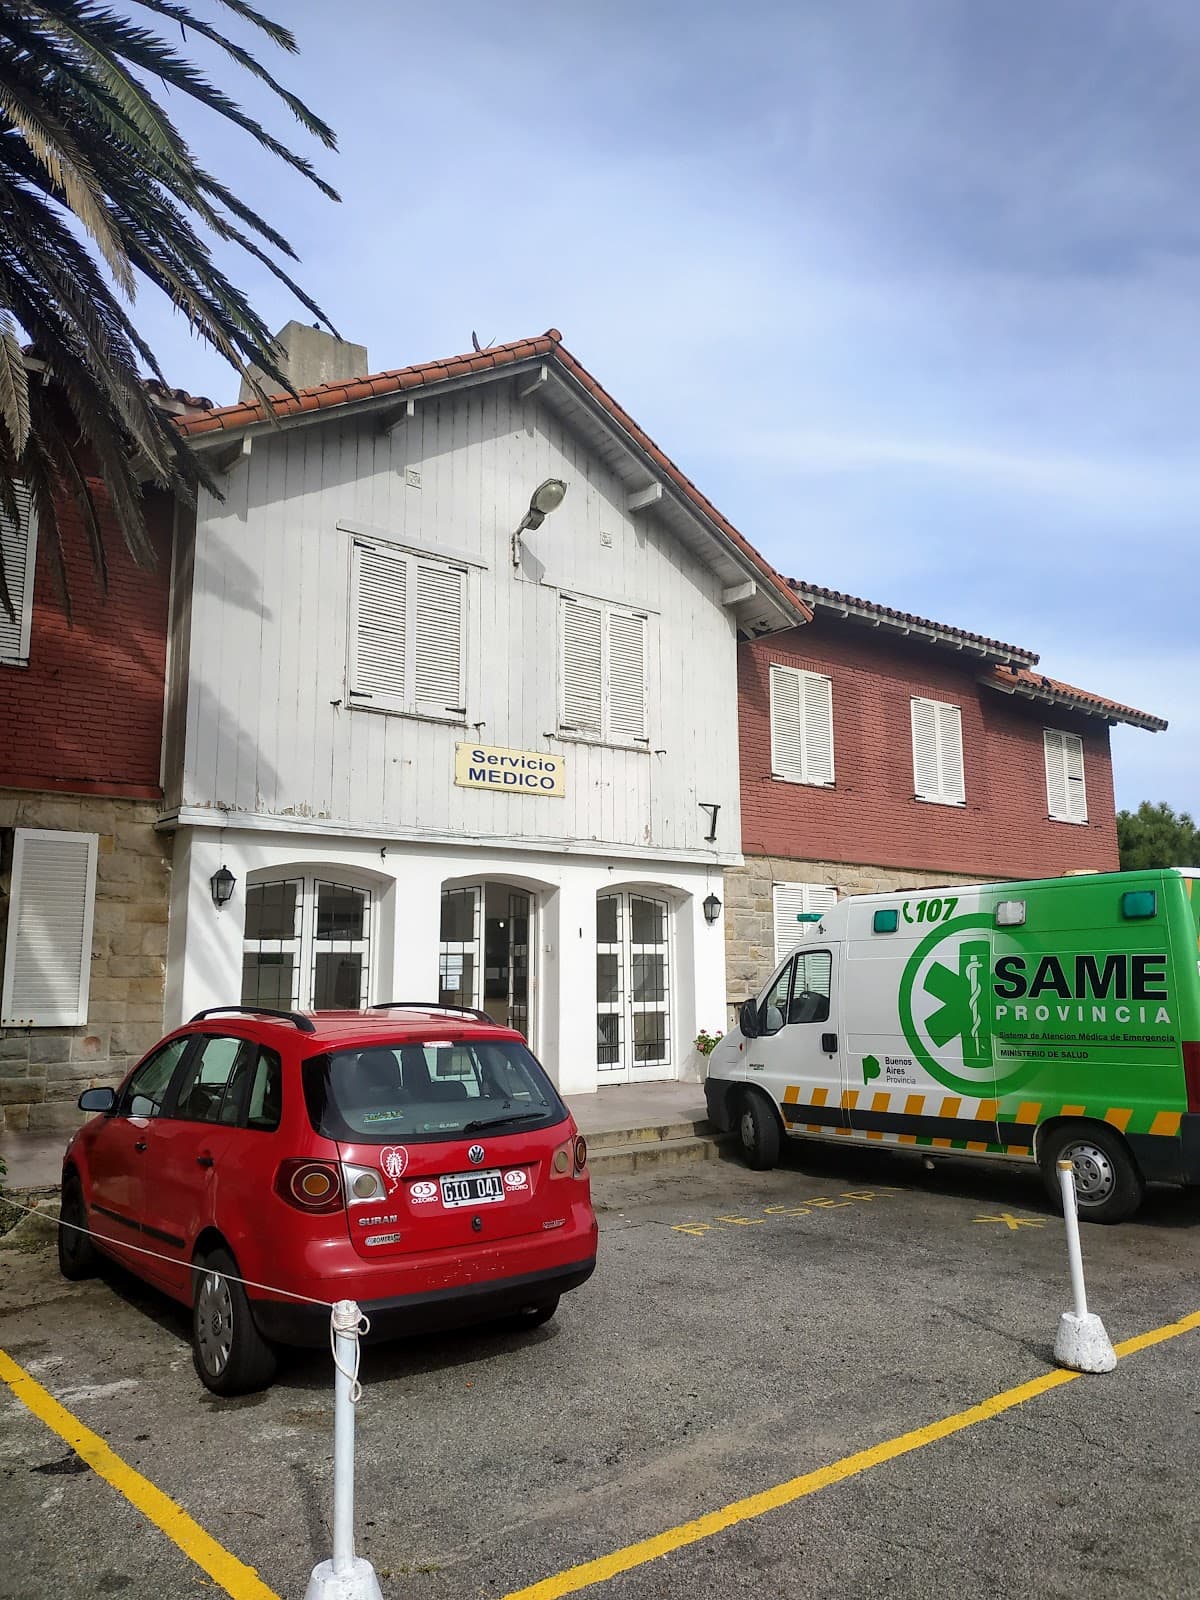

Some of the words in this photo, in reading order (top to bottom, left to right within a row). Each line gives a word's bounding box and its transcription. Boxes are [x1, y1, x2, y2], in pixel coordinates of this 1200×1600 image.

[472, 750, 556, 772] Servicio
[469, 767, 555, 790] MEDICO
[916, 898, 958, 922] 107
[993, 954, 1167, 1000] SAME
[995, 1005, 1171, 1024] PROVINCIA
[999, 1031, 1028, 1039] Sistema
[1110, 1033, 1121, 1041] de
[1122, 1033, 1175, 1042] Emergencia
[885, 1057, 912, 1066] Buenos
[1000, 1049, 1045, 1057] MINISTERIO
[1061, 1051, 1089, 1059] SALUD
[886, 1067, 905, 1075] Aires
[886, 1075, 917, 1085] Provincia
[443, 1181, 471, 1202] GIO
[476, 1177, 503, 1197] 041
[358, 1214, 398, 1226] SURAN
